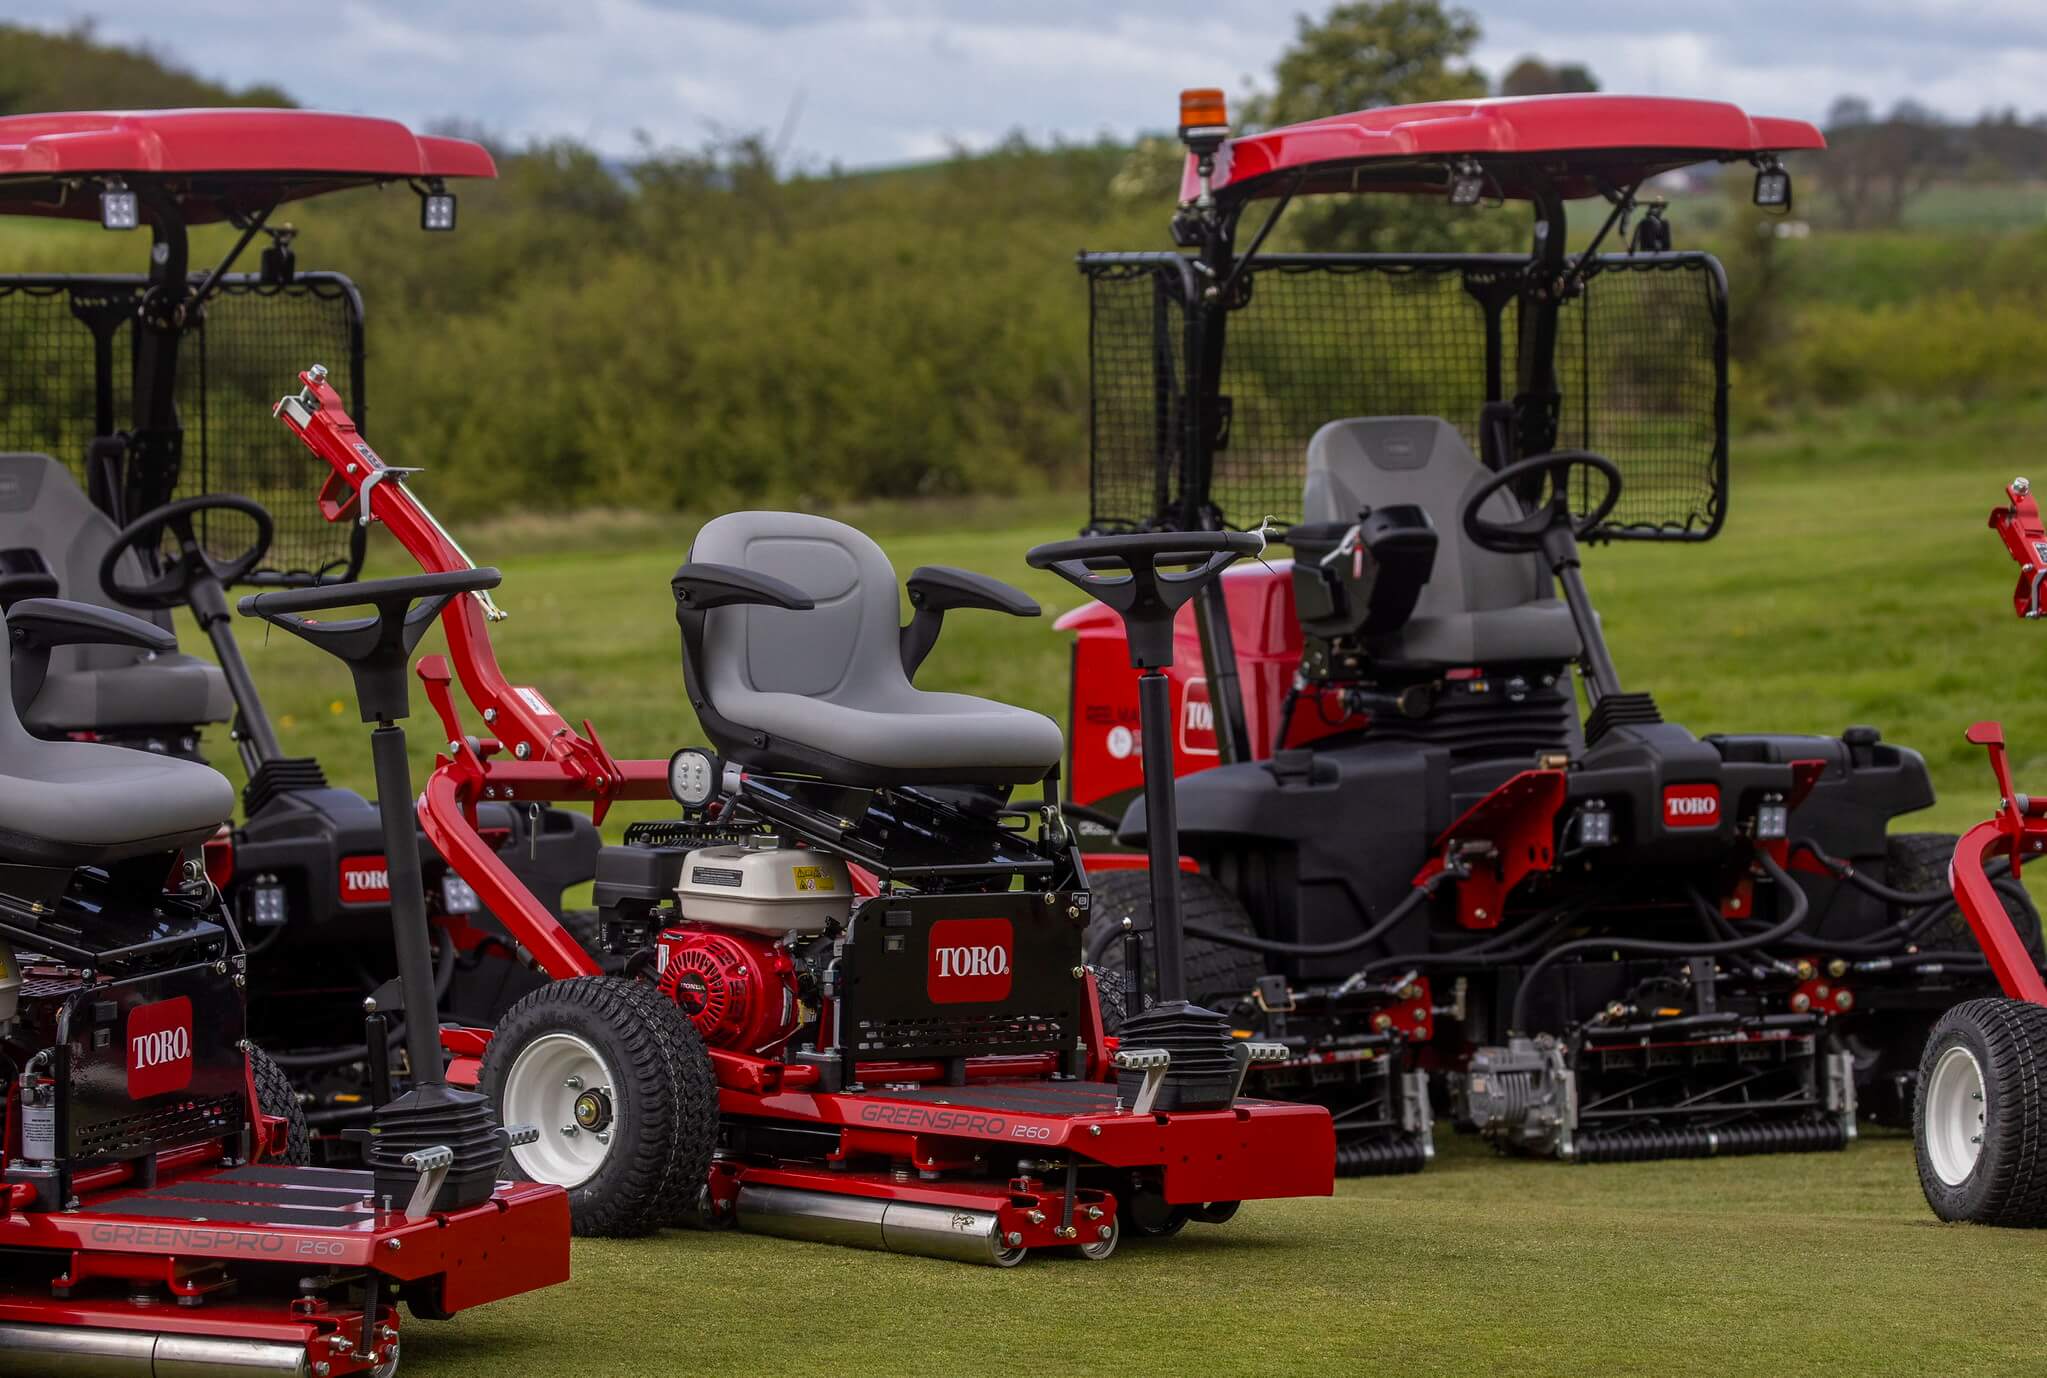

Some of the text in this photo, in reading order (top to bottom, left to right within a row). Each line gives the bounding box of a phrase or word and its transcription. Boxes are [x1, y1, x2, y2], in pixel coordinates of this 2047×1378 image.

[1667, 796, 1716, 816] TORO
[936, 945, 1008, 977] TORO
[133, 1026, 190, 1069] TORO
[861, 1104, 1050, 1139] GREENSPRO 1260
[91, 1223, 344, 1256] GREENSPRO 1260
